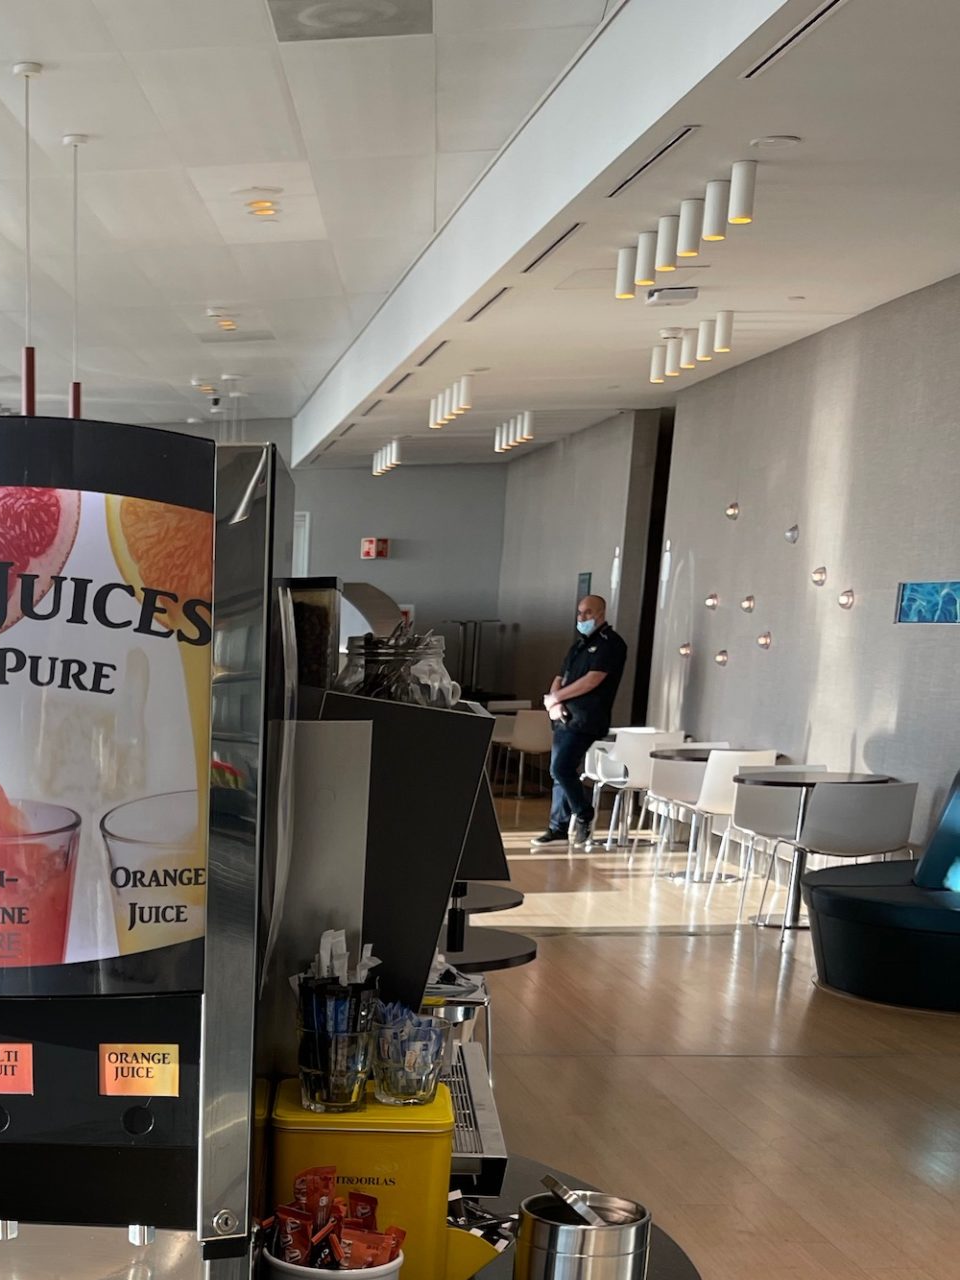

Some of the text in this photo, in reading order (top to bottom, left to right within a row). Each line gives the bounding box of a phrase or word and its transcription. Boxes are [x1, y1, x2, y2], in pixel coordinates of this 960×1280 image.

[110, 866, 206, 888] ORANGE
[127, 902, 188, 931] JUICE
[108, 1051, 171, 1064] ORANGE
[114, 1066, 154, 1081] JUICE
